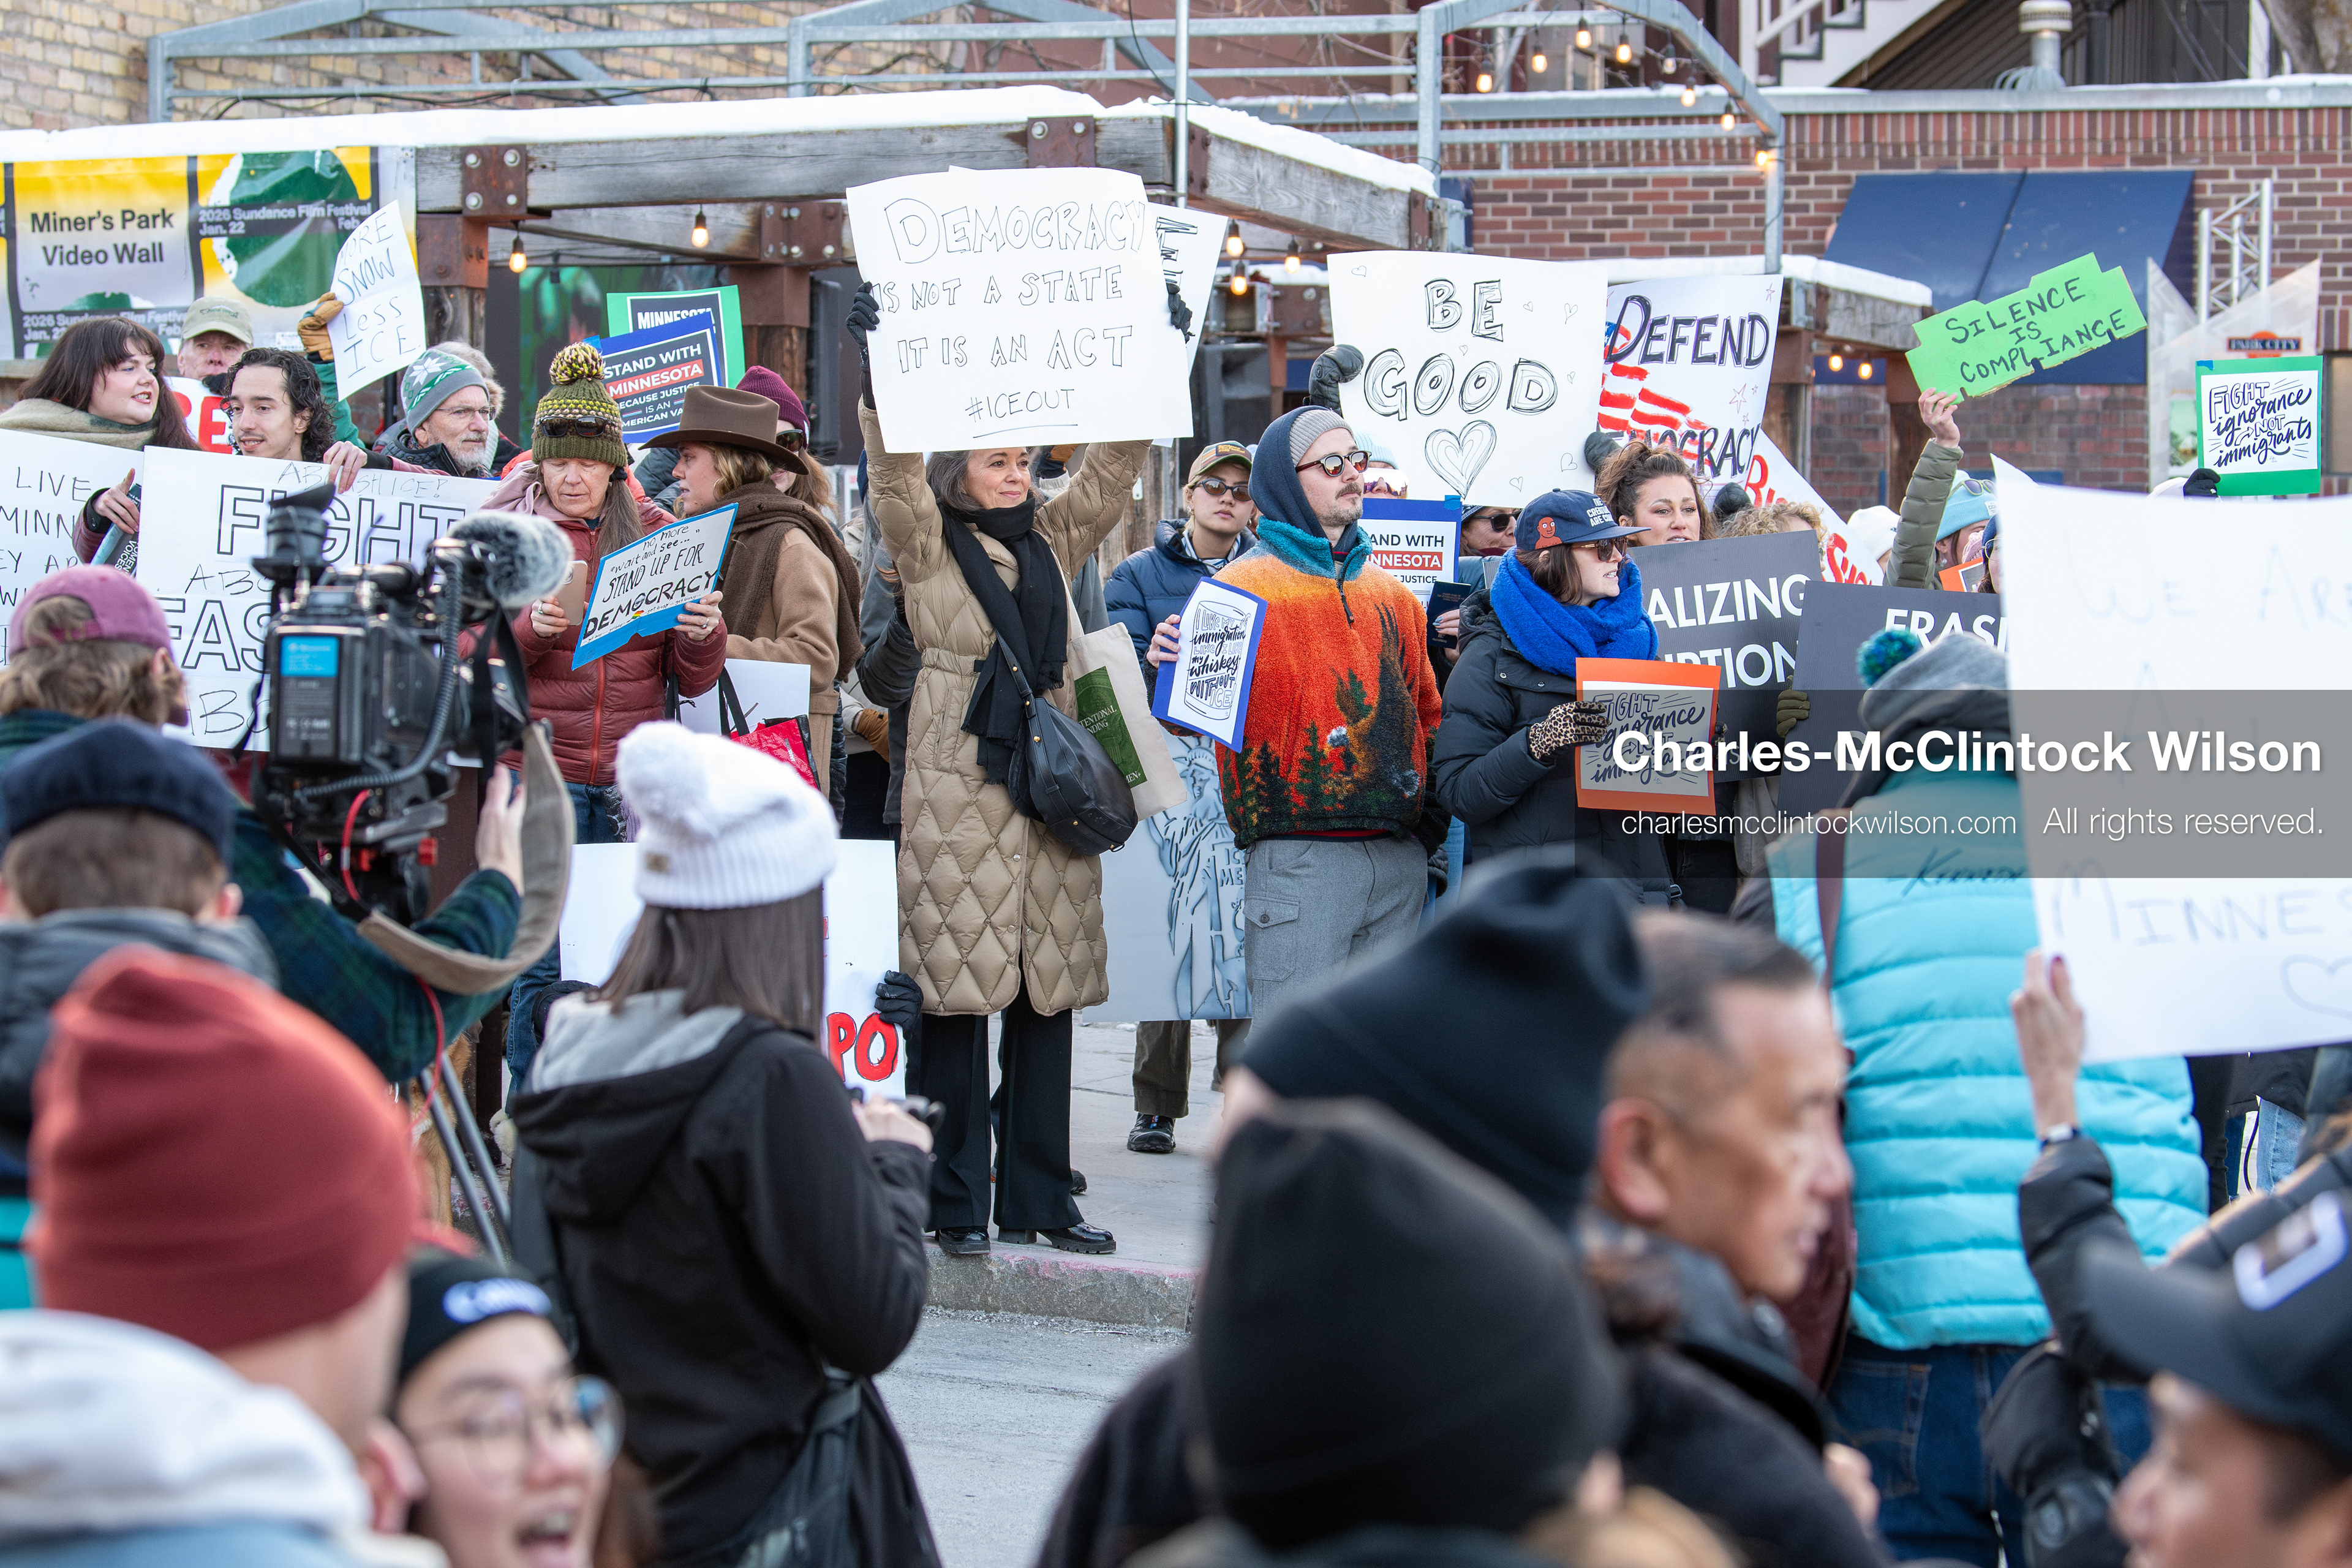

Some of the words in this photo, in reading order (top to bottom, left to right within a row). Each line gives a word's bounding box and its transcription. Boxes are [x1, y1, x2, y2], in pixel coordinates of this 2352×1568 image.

[31, 211, 114, 233] Miner’s
[121, 208, 175, 229] Park
[233, 206, 296, 220] Sundance
[298, 202, 325, 217] Film
[326, 202, 372, 216] Festival
[199, 223, 227, 236] Jan.
[228, 221, 245, 233] 22
[884, 198, 1145, 264] DEMOCRACY
[42, 245, 108, 265] Video
[113, 242, 164, 263] Wall
[337, 247, 394, 306] SNOW
[872, 281, 900, 314] IS
[912, 278, 961, 311] NOT
[984, 275, 1001, 304] A
[1019, 265, 1122, 306] STATE
[1424, 278, 1504, 342] BE
[1945, 276, 2086, 345] SILENCE
[23, 329, 50, 341] Jan.
[1604, 294, 1770, 369] DEFEND
[2015, 321, 2042, 345] IS
[2267, 339, 2299, 350] CITY
[897, 337, 929, 373] IT
[942, 336, 968, 367] IS
[990, 334, 1027, 368] AN
[1047, 325, 1133, 369] ACT
[1959, 307, 2127, 383] COMPLIANCE
[603, 356, 656, 379] STAND
[659, 343, 702, 364] WITH
[609, 363, 703, 397] MINNESOTA
[1363, 348, 1558, 421] GOOD
[617, 393, 658, 410] ECAUSE
[645, 405, 655, 413] IS
[656, 401, 671, 411] AN
[965, 388, 1075, 423] #ICEOUT
[2209, 382, 2270, 424] FIGHT
[2213, 388, 2312, 447] ignorance
[2255, 414, 2285, 437] NOT
[2213, 416, 2312, 467] immigrants
[17, 466, 91, 502] LIVE
[1593, 497, 1603, 507] THE
[1590, 515, 1604, 527] ARE
[643, 537, 655, 550] no
[661, 526, 689, 541] more
[1405, 534, 1444, 547] WITH
[115, 540, 137, 571] VOICES
[642, 543, 657, 560] and
[602, 565, 646, 603] STAND
[650, 553, 671, 576] UP
[674, 543, 704, 571] FOR
[582, 568, 718, 640] DEMOCRACY
[1196, 609, 1200, 630] I
[1221, 617, 1235, 628] MY
[1189, 624, 1246, 657] immigration
[1222, 644, 1227, 654] I
[1187, 654, 1242, 676] whiskey
[1192, 655, 1204, 664] my
[1190, 674, 1235, 700] WITHOUT
[1079, 705, 1117, 728] TENTIONAL
